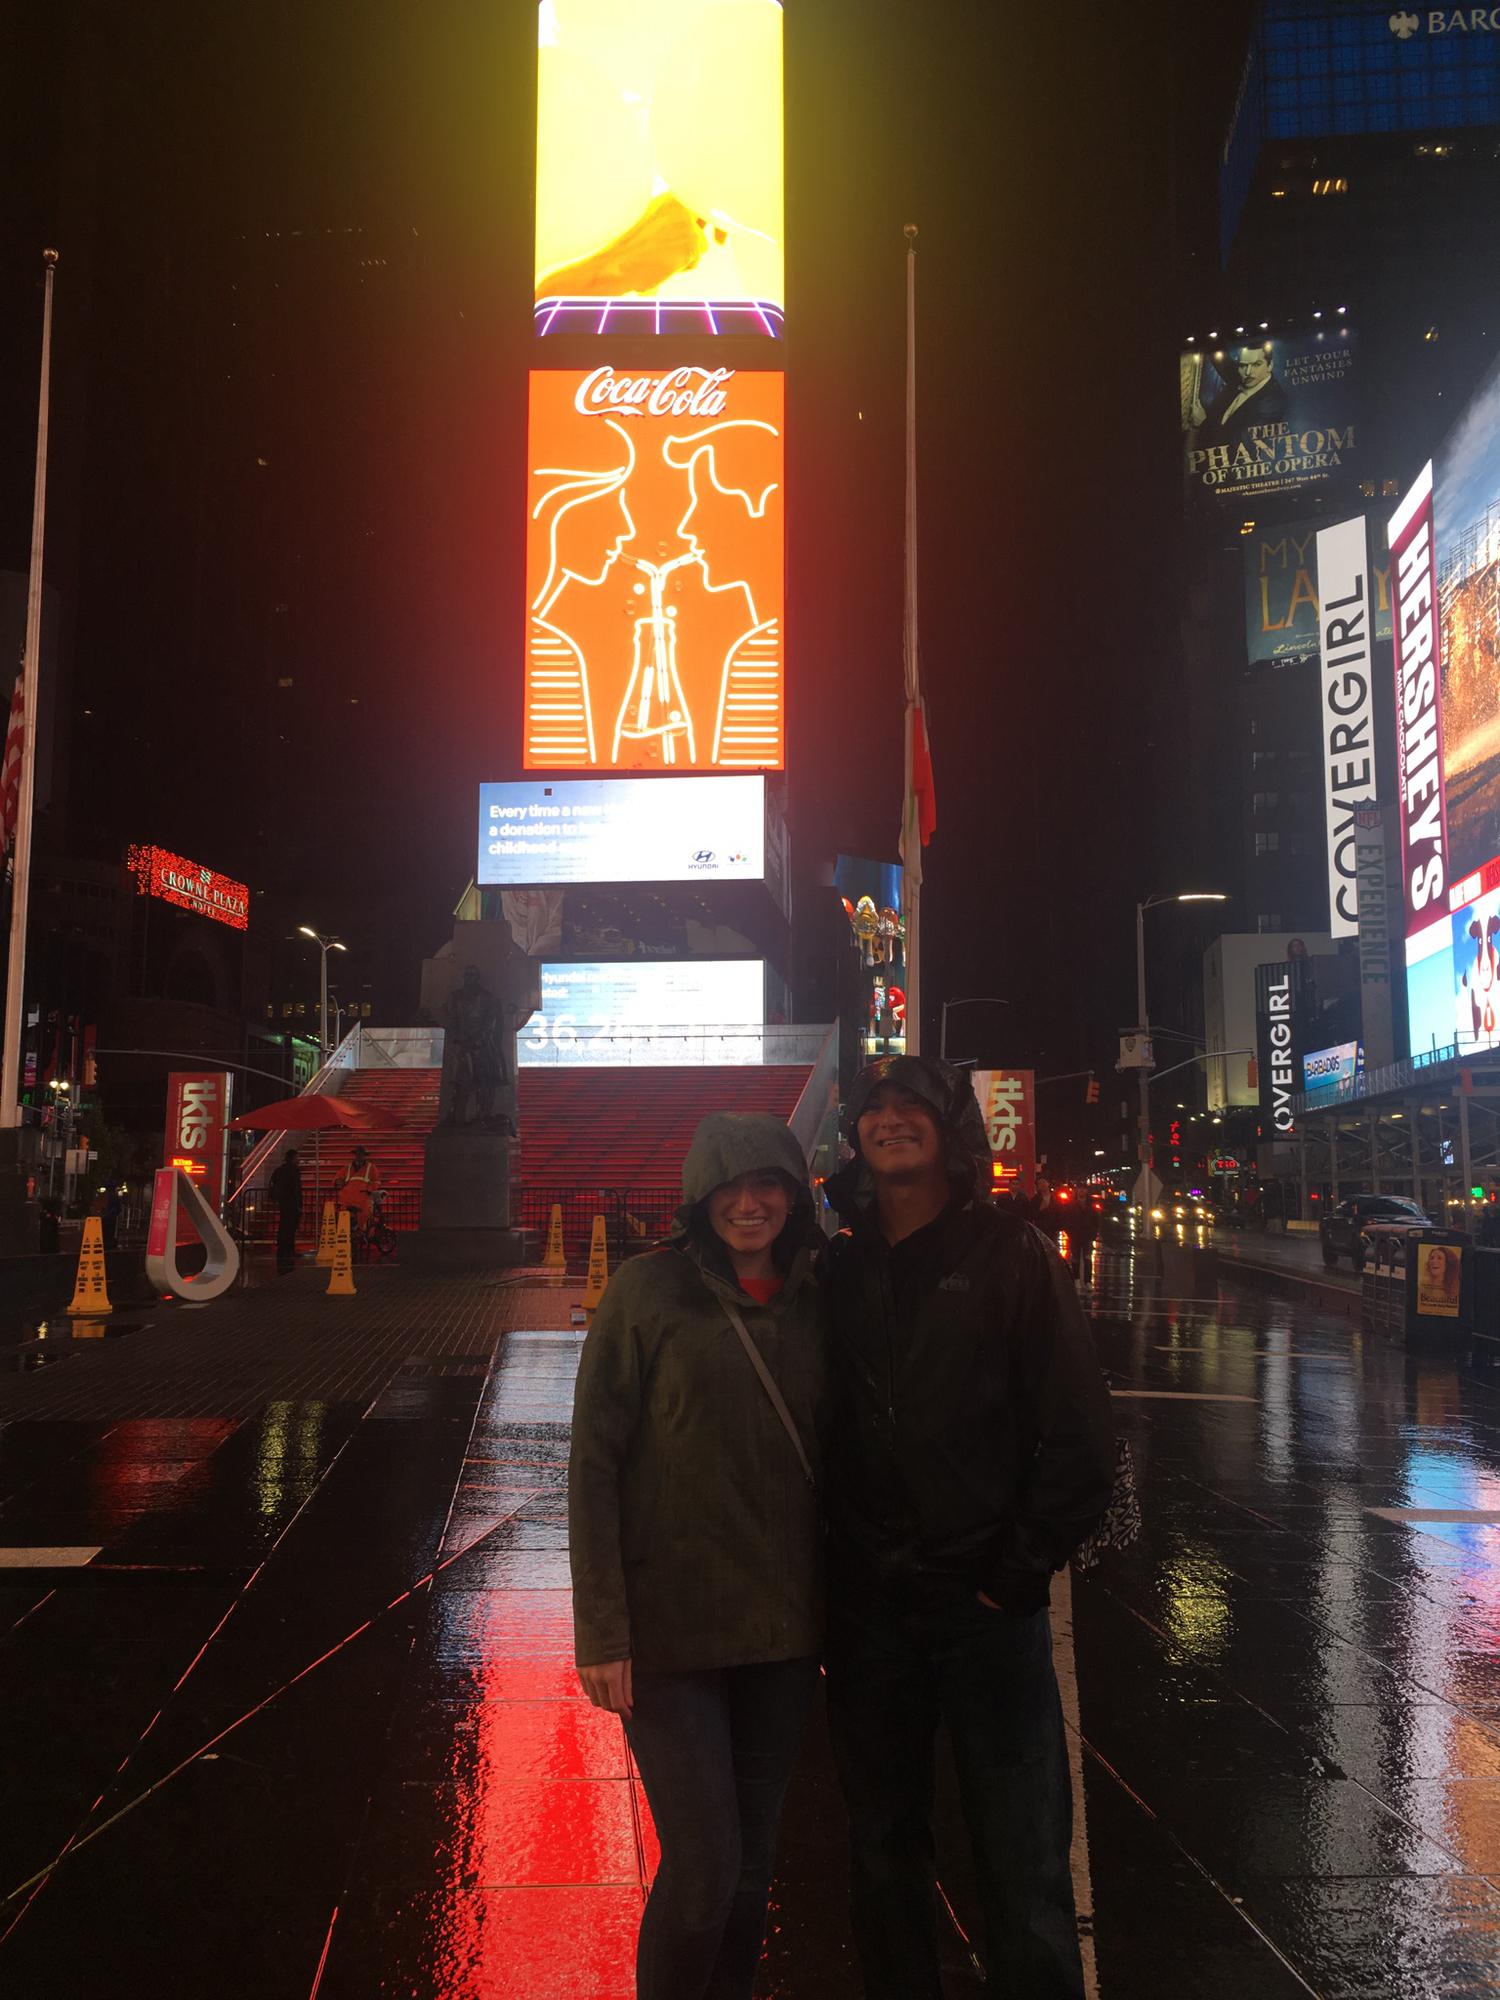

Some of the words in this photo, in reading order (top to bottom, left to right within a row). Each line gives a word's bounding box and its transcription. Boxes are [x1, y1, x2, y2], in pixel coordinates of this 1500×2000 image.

[1283, 358, 1353, 377] FANTASIES
[1285, 356, 1310, 367] LET
[1315, 349, 1352, 362] YOUR
[1291, 370, 1345, 385] UNWIND
[575, 366, 736, 415] Coca-Cola
[1186, 426, 1357, 474] PHANTOM
[1247, 421, 1290, 440] THE
[1202, 468, 1230, 485] OF
[1232, 461, 1273, 481] THE
[1274, 451, 1342, 474] OPERA
[1258, 530, 1314, 573] MY
[1259, 564, 1393, 632] LAY
[1398, 520, 1444, 911] HERSHEY'S
[489, 805, 527, 819] Every
[529, 804, 560, 817] time
[562, 806, 571, 817] a
[489, 826, 498, 836] a
[500, 823, 561, 835] donation
[562, 823, 577, 835] to
[160, 867, 209, 900] CROWNE
[213, 889, 245, 914] PLAZA
[1357, 844, 1389, 984] EXPERIENCE
[1268, 975, 1294, 1131] OVERGIRL
[180, 1079, 218, 1150] tkts
[988, 1077, 1025, 1152] tkts
